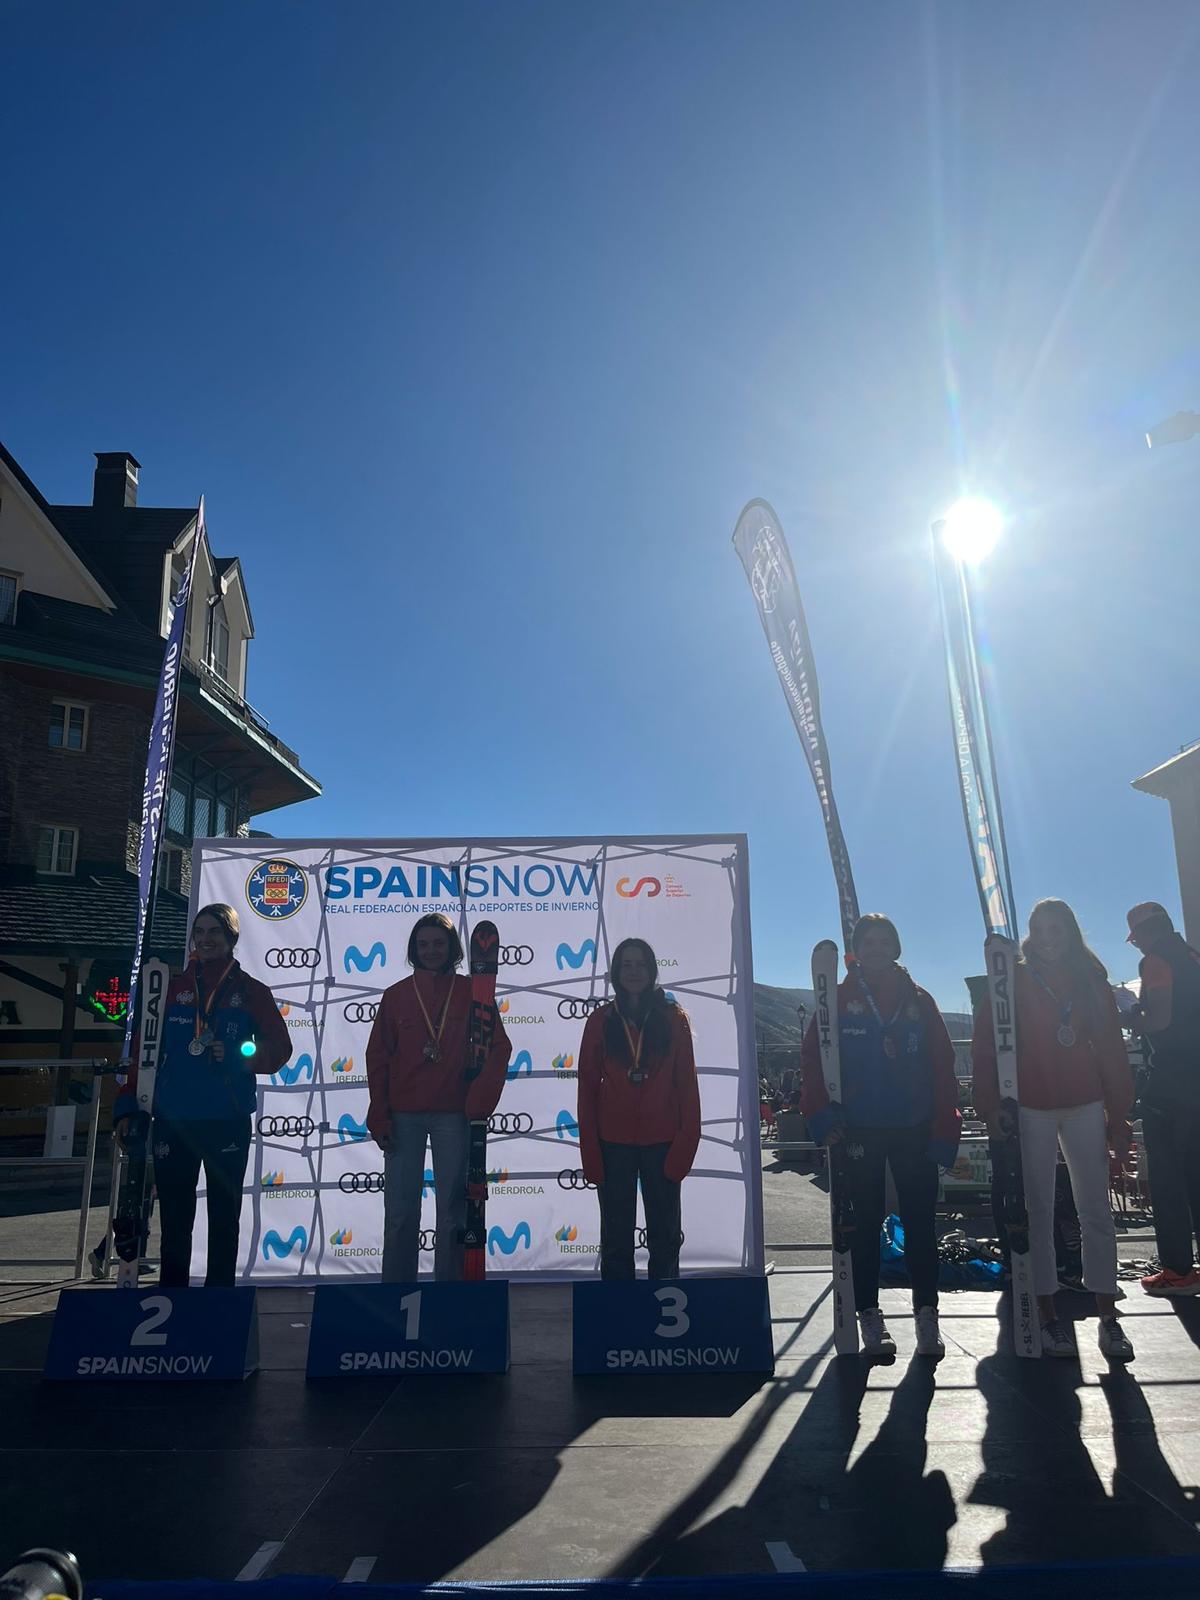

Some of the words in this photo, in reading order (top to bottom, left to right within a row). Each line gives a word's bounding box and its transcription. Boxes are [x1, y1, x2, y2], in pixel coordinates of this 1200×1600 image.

[323, 864, 599, 899] SPAINSNOW
[323, 904, 351, 914] REAL
[353, 902, 420, 914] FEDERACIÓN
[422, 901, 478, 913] ESPAÑOLA
[479, 903, 533, 913] DEPORTES
[535, 903, 549, 912] DE
[551, 902, 600, 912] INVIERNO
[817, 974, 832, 1045] HEAD
[990, 950, 1016, 1053] HEAD
[141, 969, 164, 1068] HEAD
[284, 1018, 325, 1028] ERDROLA
[502, 1016, 545, 1024] ERDROLA
[336, 1075, 369, 1084] IBERDR
[265, 1190, 319, 1199] IBERDROLA
[491, 1186, 545, 1195] IBERDROLA
[334, 1248, 384, 1257] IBERDROL
[560, 1244, 601, 1254] IBERDRO
[130, 1295, 173, 1346] 2
[400, 1290, 422, 1340] 1
[654, 1286, 690, 1338] 3
[76, 1356, 213, 1375] SPAINSNOW
[339, 1349, 473, 1370] SPAINSNOW
[606, 1347, 740, 1368] SPAINSNOW
